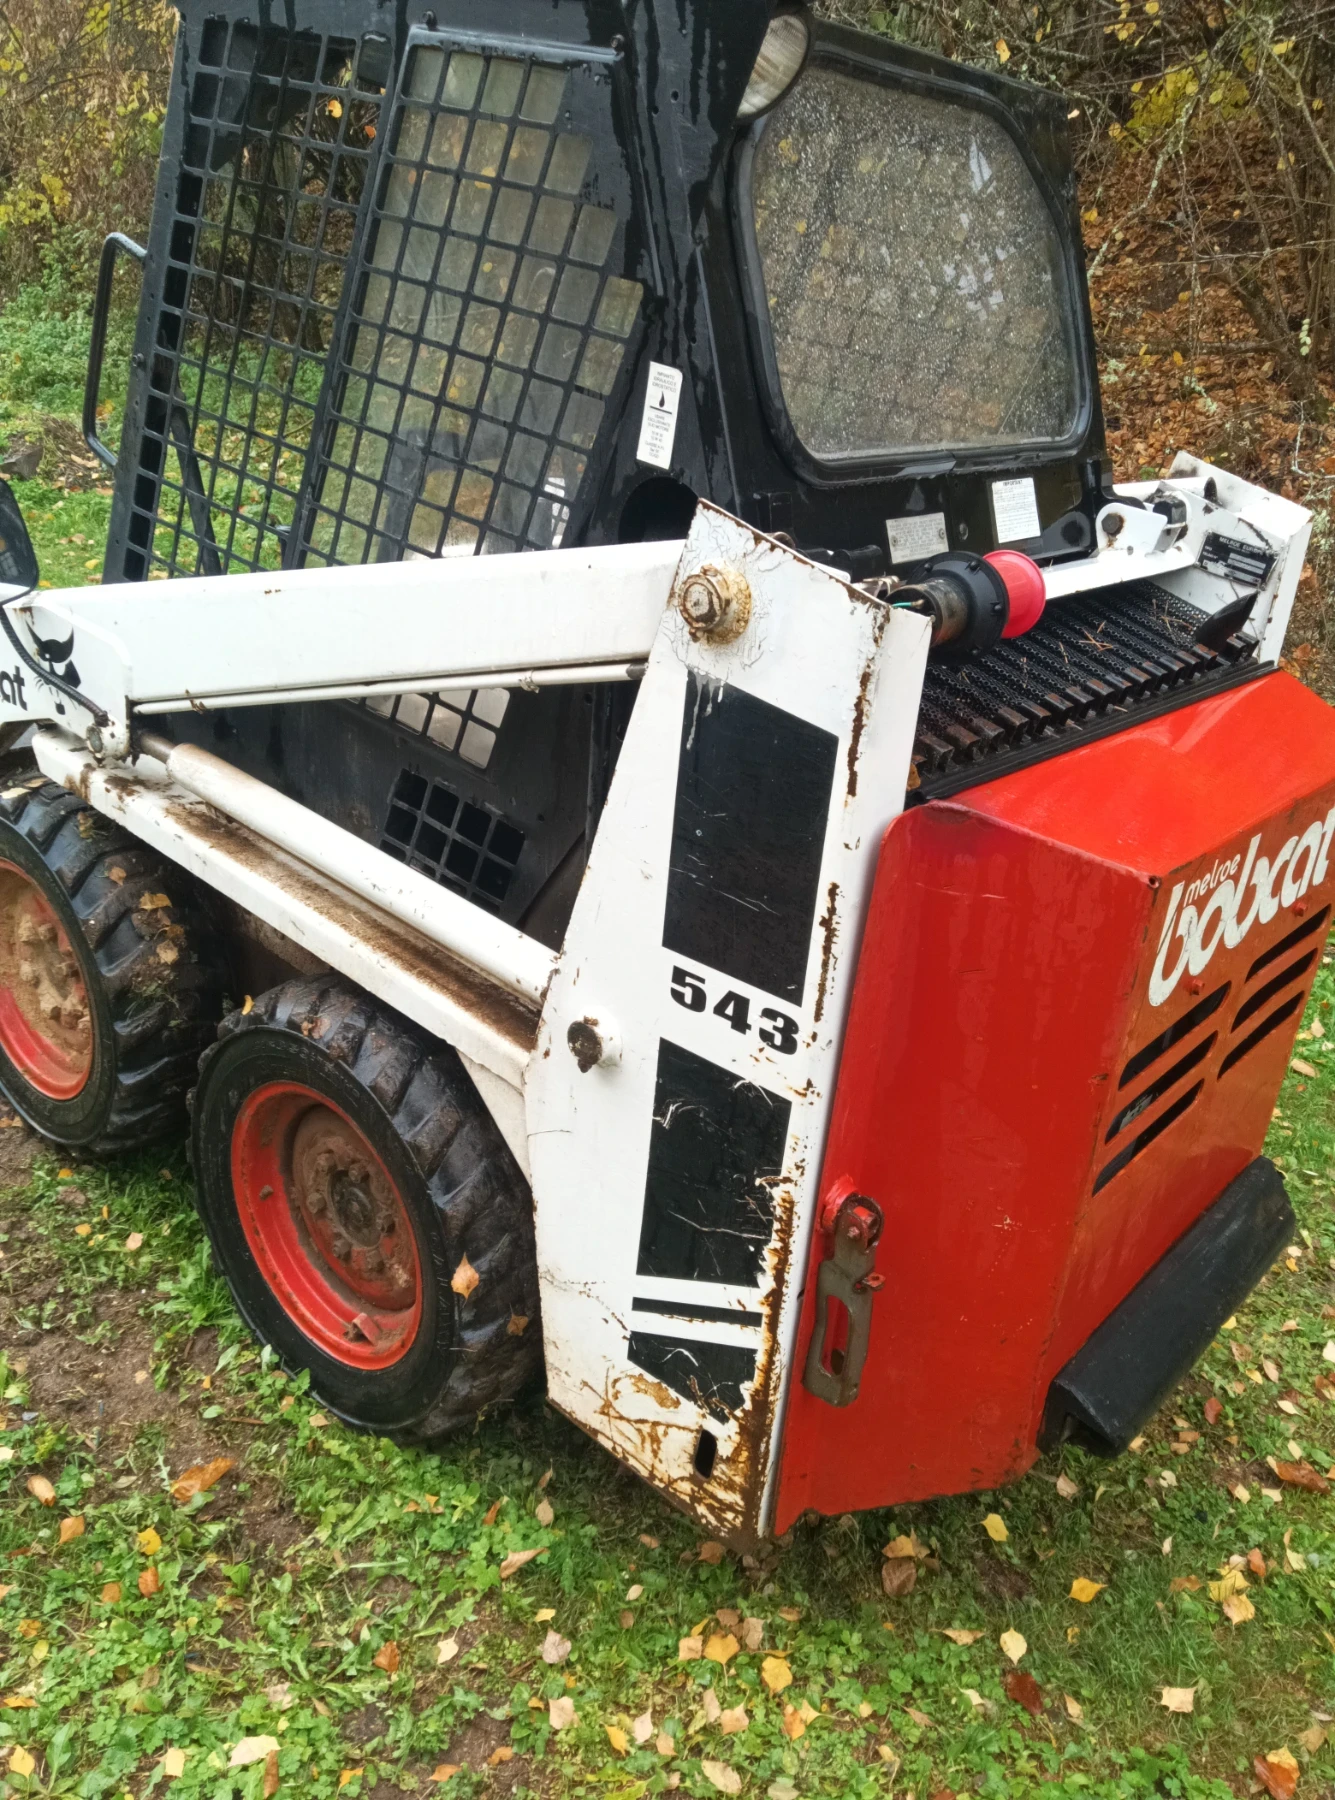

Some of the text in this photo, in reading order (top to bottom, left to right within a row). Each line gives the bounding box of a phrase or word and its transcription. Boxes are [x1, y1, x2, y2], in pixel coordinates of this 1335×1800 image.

[1219, 536, 1241, 547] MELROE
[1184, 853, 1241, 907] melroe
[670, 965, 799, 1055] 543
